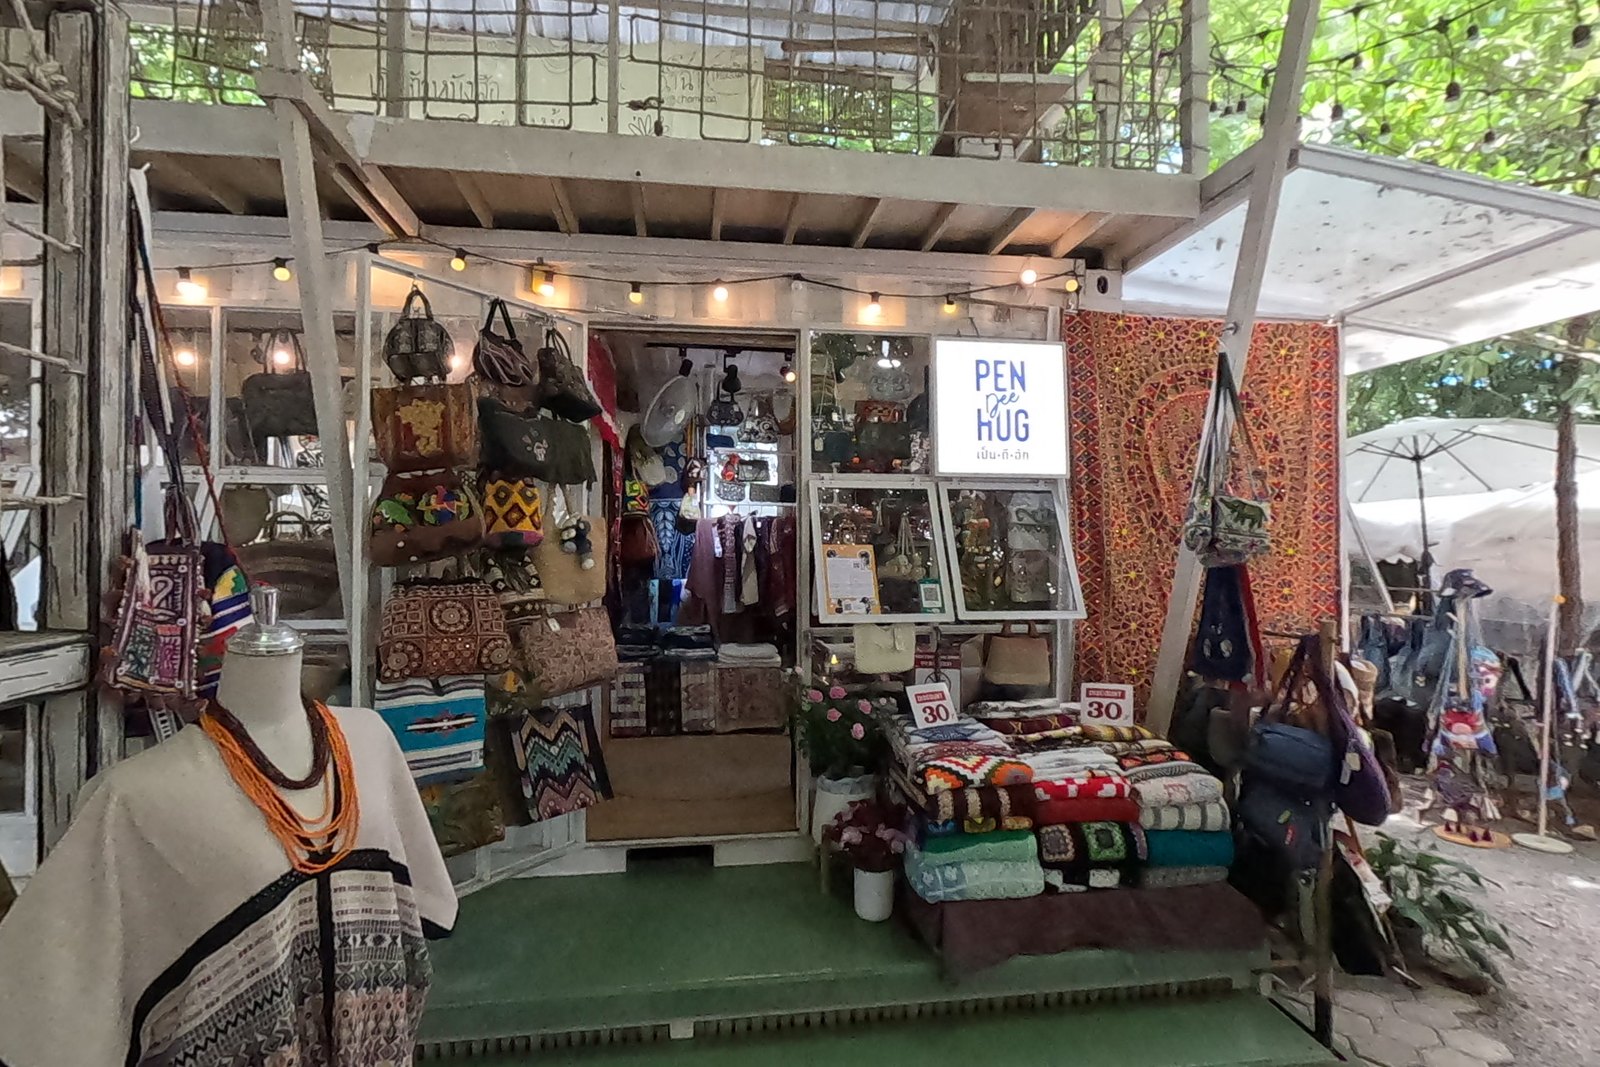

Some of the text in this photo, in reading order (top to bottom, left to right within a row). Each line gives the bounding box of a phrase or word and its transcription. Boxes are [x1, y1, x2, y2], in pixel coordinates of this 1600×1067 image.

[975, 359, 1026, 392] PEN
[977, 408, 1029, 442] HUG
[922, 703, 950, 724] 30
[1087, 701, 1122, 720] 30
